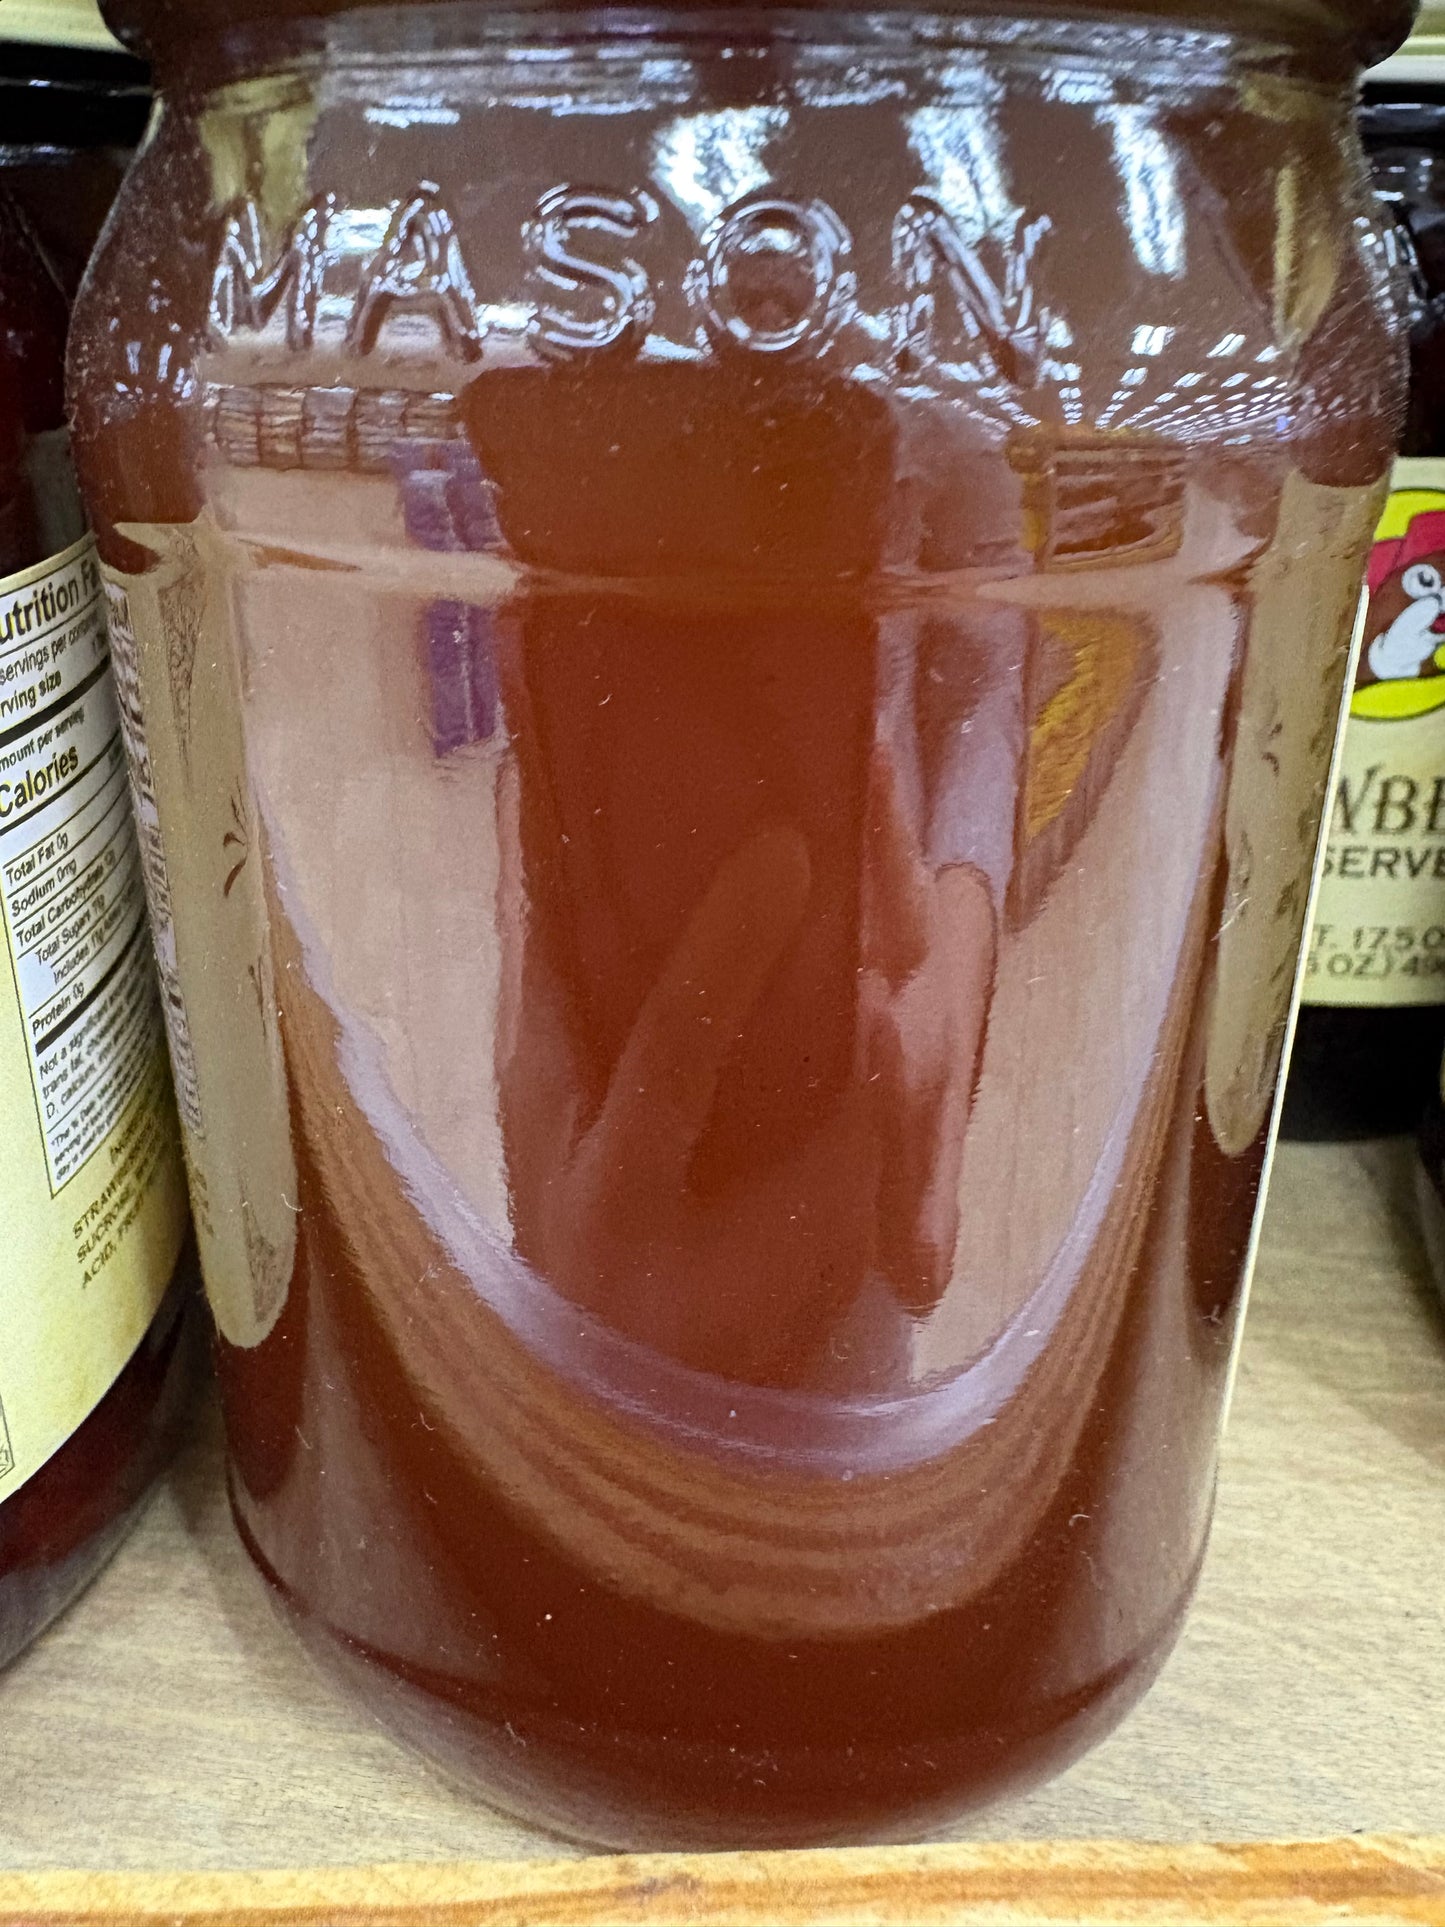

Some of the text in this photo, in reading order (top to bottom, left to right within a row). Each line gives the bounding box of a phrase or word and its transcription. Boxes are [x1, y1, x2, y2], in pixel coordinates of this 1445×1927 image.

[205, 178, 1056, 372] MASON
[38, 669, 62, 697] size
[37, 728, 53, 755] per
[0, 745, 79, 818] Calories
[5, 831, 69, 887] Total Fat 0g
[11, 858, 78, 918] Sodium 0mg
[16, 914, 46, 947] Total
[34, 934, 61, 966] Total
[32, 993, 72, 1037] Protein
[39, 1052, 59, 1081] Not
